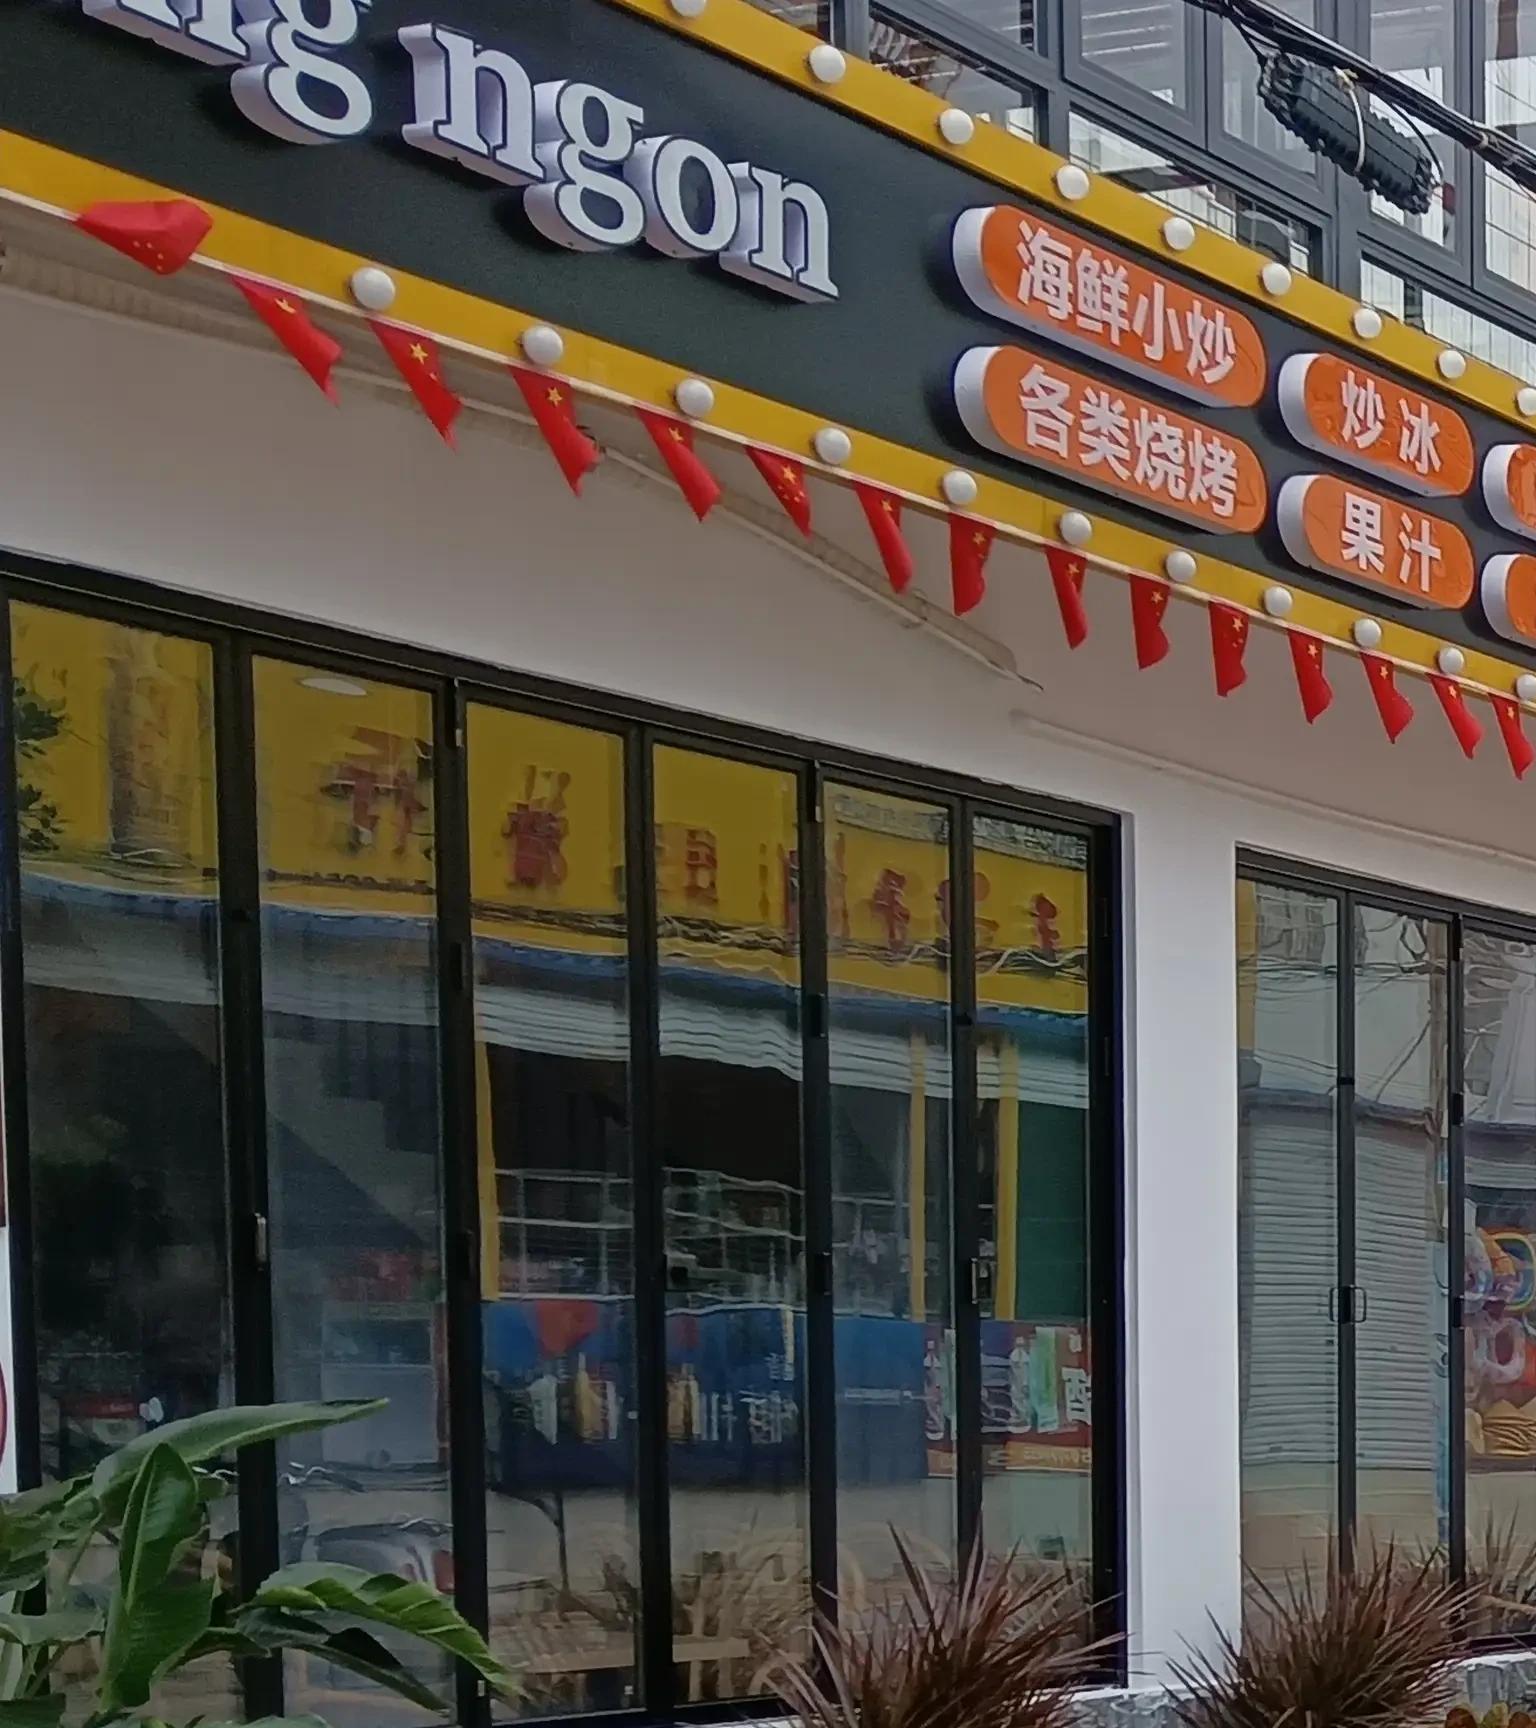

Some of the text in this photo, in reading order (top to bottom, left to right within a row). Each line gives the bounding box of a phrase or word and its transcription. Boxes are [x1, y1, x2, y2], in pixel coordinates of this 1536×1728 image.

[83, 0, 840, 303] g ngon
[1016, 219, 1237, 384] 海鲜小炒
[1019, 364, 1239, 518] 各类烧烤
[1341, 369, 1442, 476] 炒冰
[1341, 491, 1441, 593] 果汁
